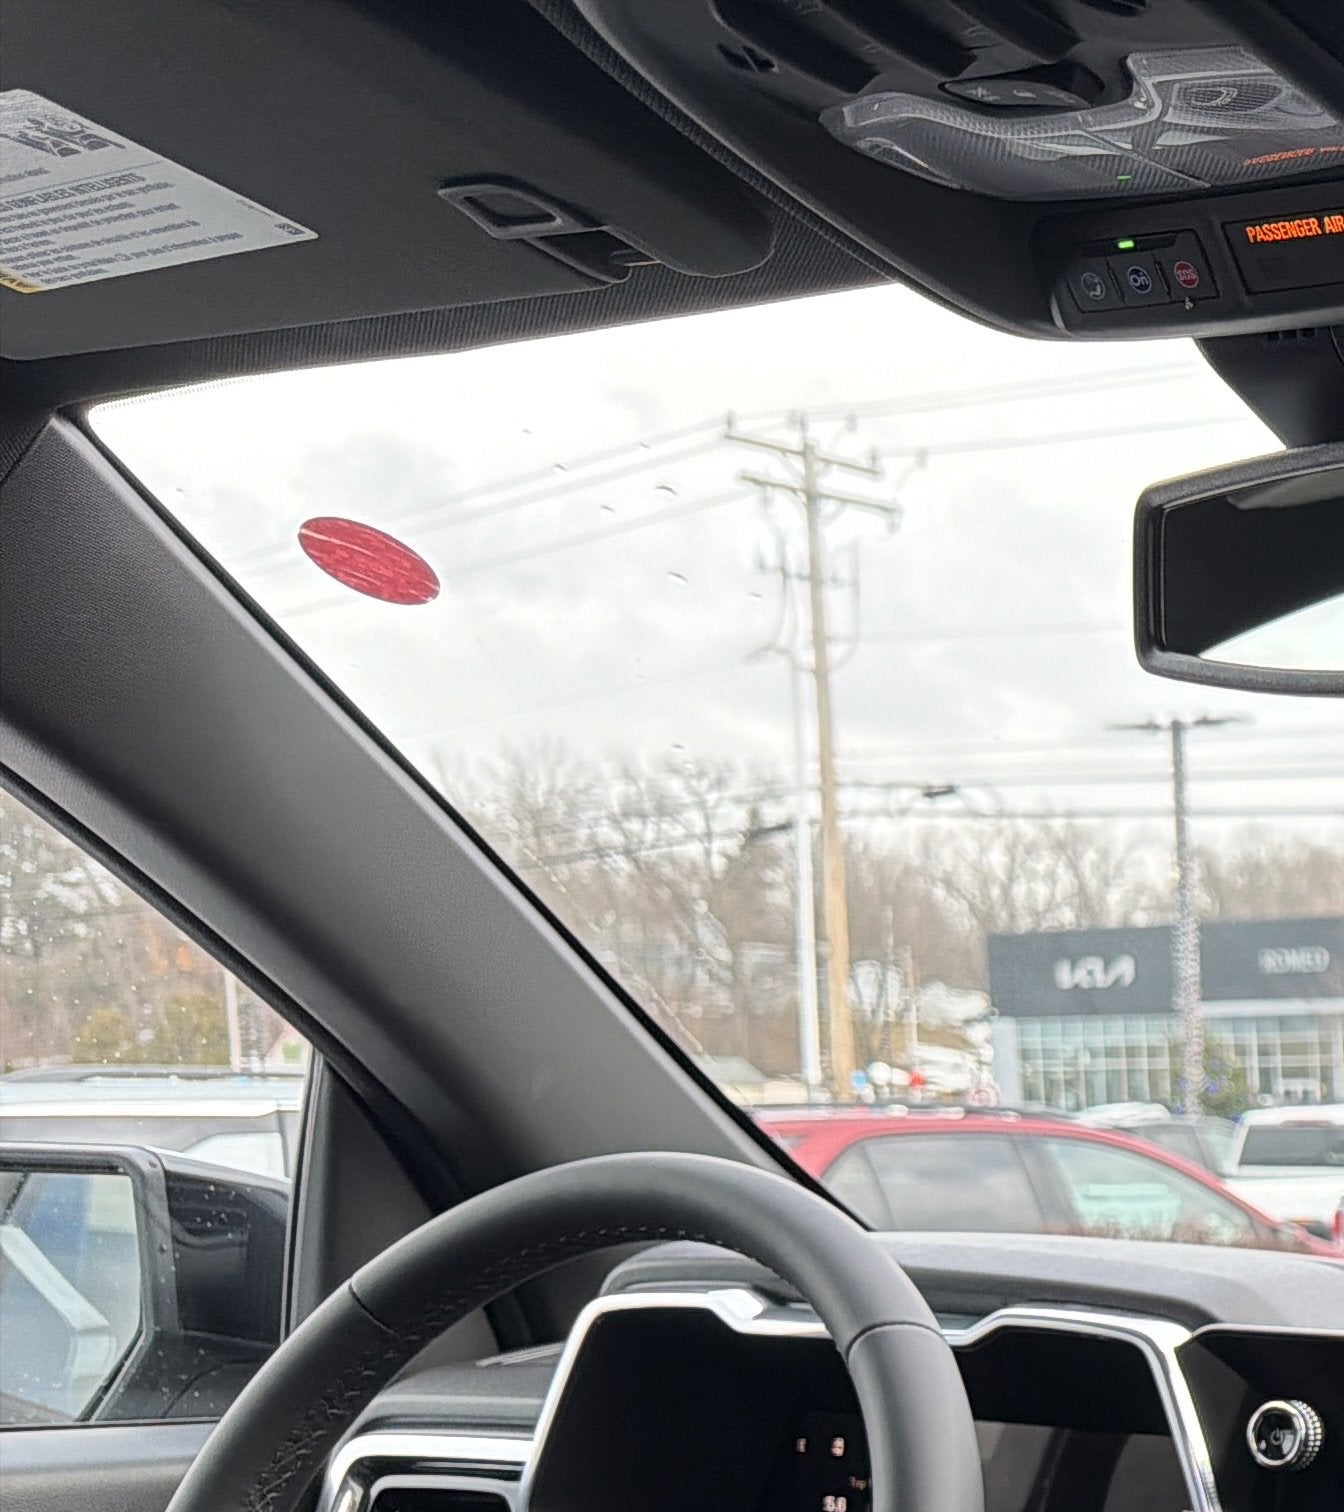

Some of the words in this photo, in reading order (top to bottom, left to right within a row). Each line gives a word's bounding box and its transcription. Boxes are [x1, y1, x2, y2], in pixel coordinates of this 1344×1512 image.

[1245, 217, 1322, 243] PASSENGER
[1129, 273, 1148, 288] On
[1054, 954, 1136, 990] KIA
